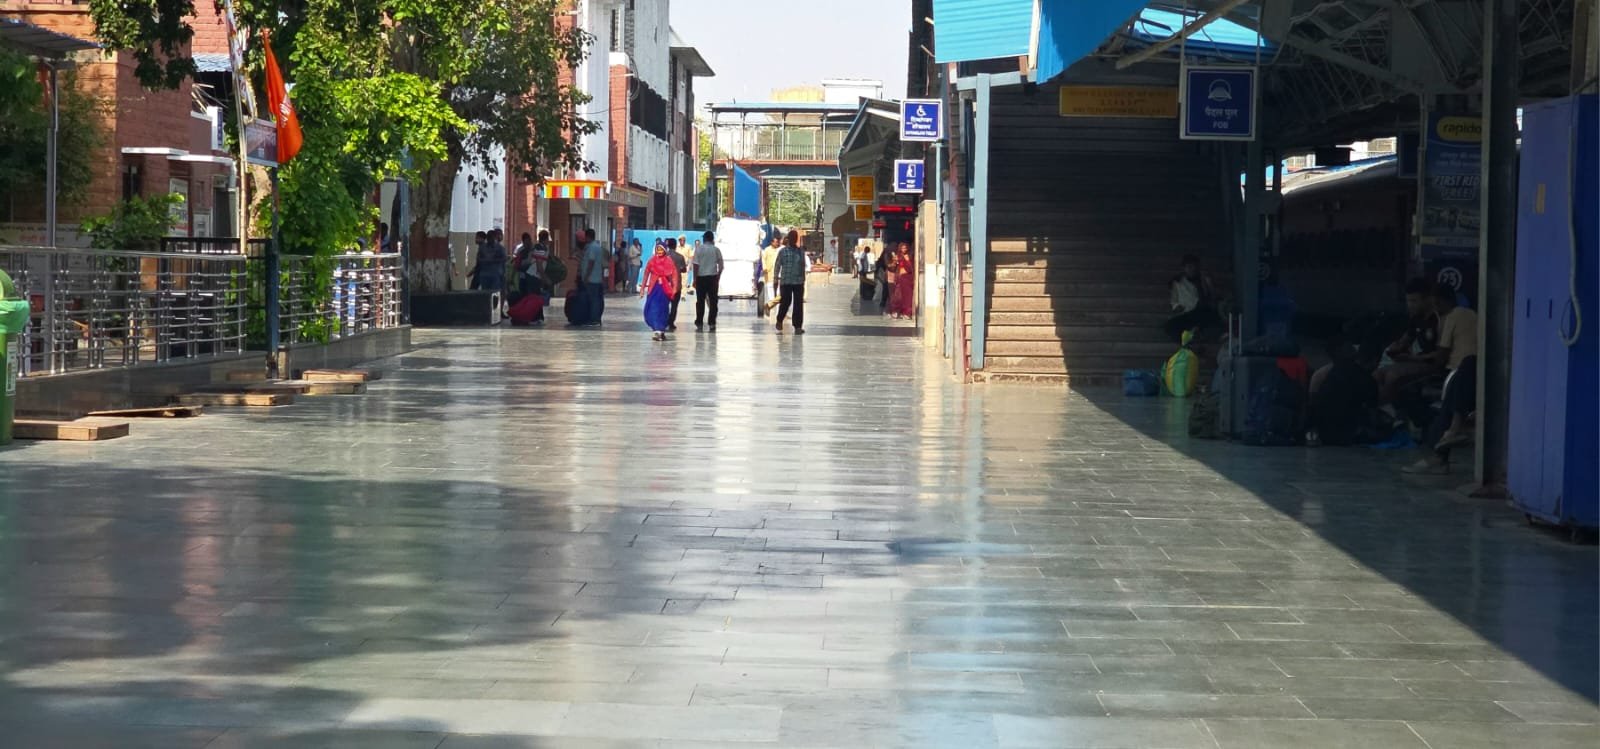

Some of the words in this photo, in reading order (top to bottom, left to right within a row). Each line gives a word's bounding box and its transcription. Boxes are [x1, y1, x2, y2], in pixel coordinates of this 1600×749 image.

[1212, 120, 1229, 129] FOB
[1443, 122, 1481, 136] rapido
[1434, 175, 1461, 187] FIRST
[1462, 175, 1481, 187] RID
